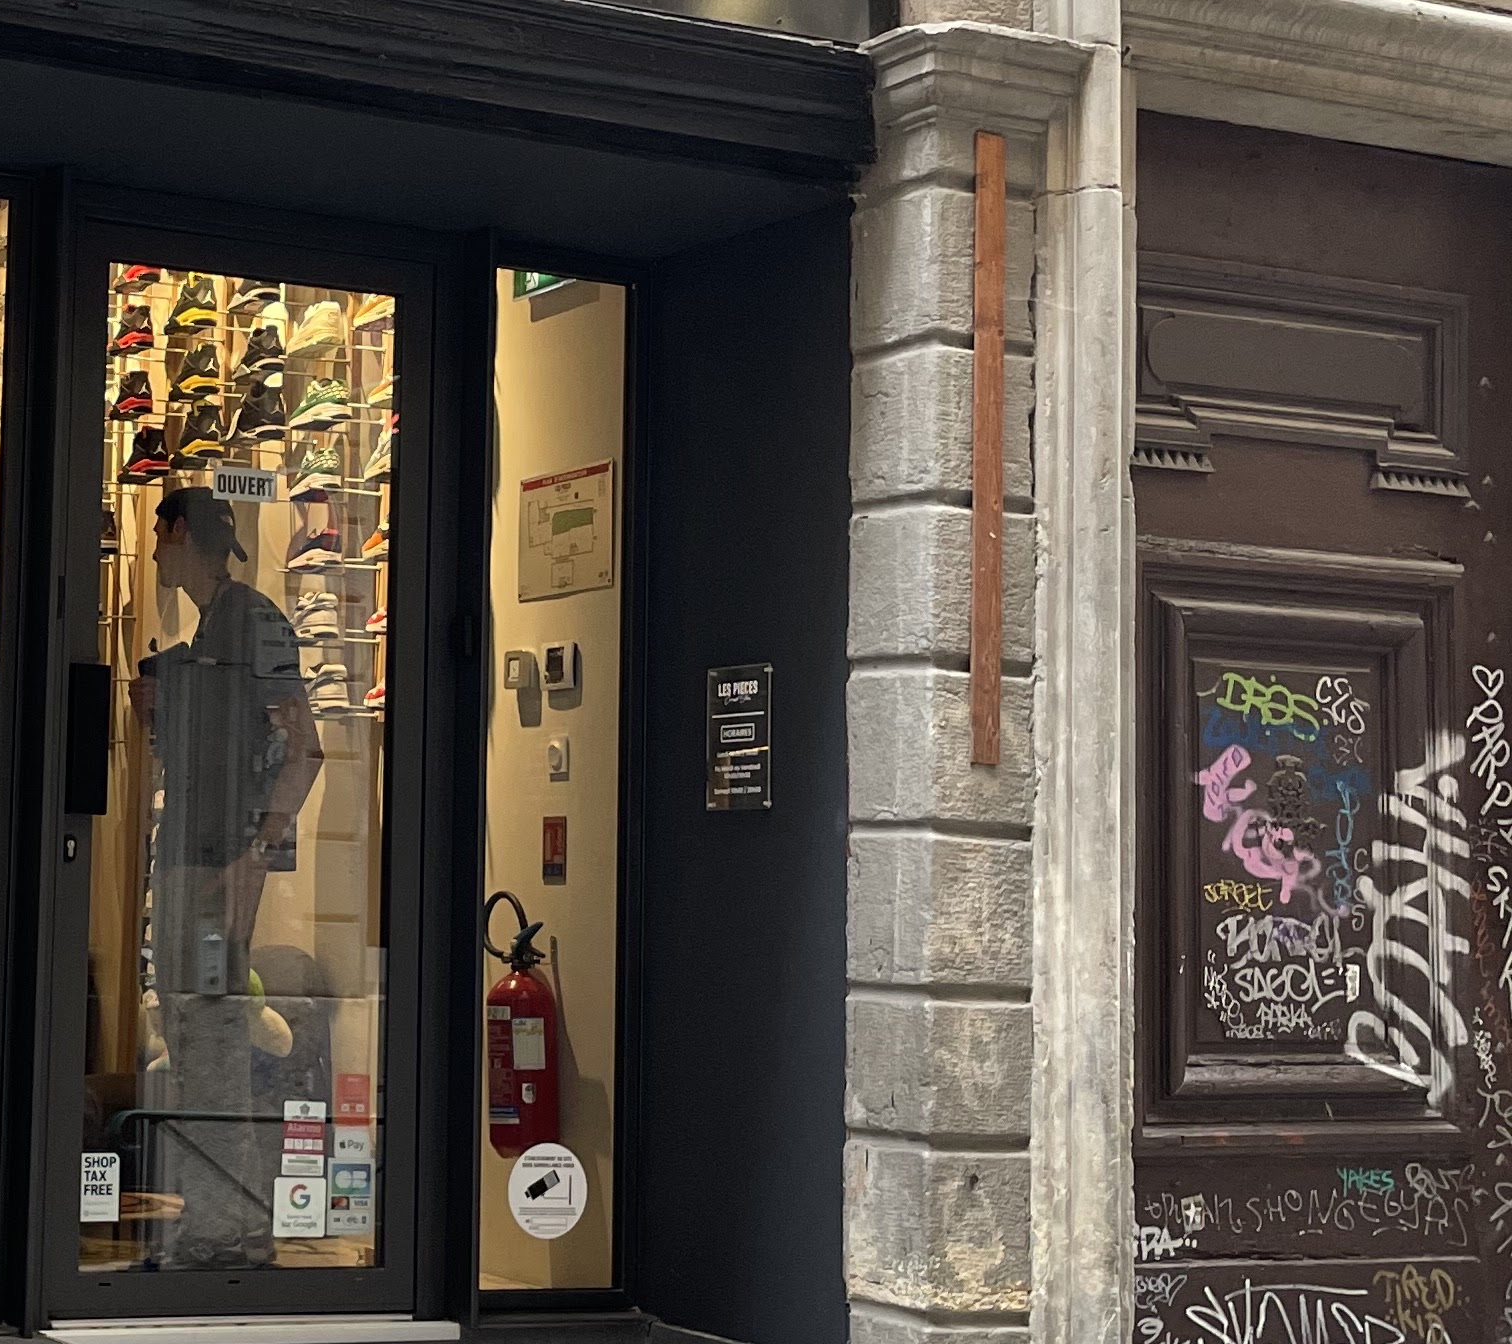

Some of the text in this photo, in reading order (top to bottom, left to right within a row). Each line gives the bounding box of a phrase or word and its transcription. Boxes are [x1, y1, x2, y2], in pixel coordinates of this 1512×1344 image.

[217, 473, 274, 497] OUVERT
[717, 679, 759, 698] LES PIECES
[347, 1139, 365, 1152] Pay
[84, 1156, 117, 1168] SHOP
[83, 1170, 108, 1182] TAX
[83, 1183, 114, 1196] FREE
